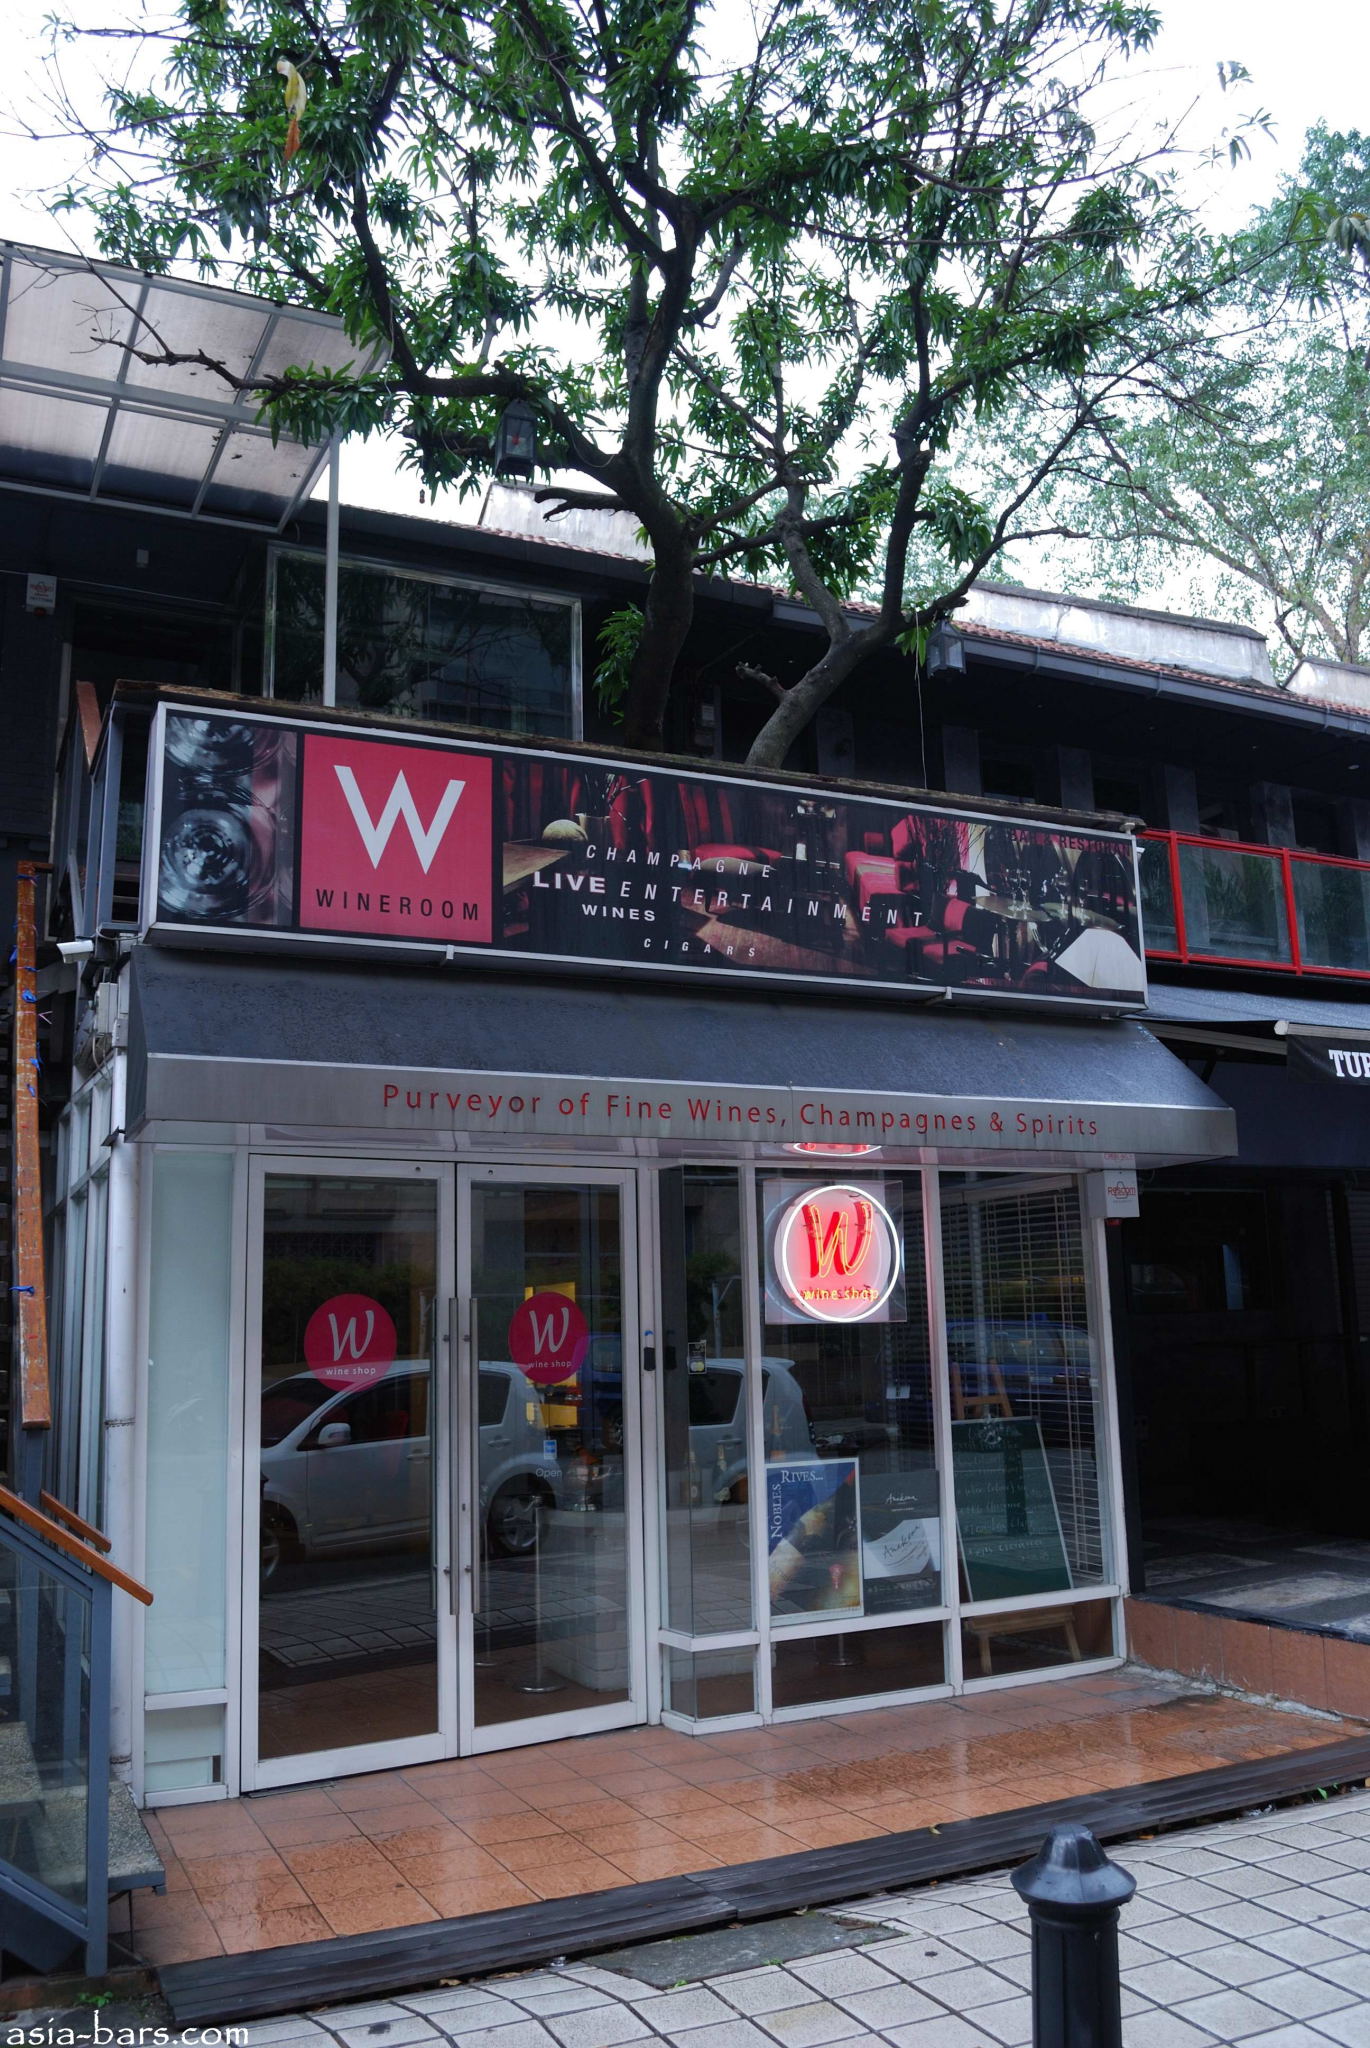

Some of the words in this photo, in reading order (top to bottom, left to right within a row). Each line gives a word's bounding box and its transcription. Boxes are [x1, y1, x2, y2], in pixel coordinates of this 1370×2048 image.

[333, 764, 467, 876] W
[585, 844, 772, 879] CHAMPAGNE
[315, 888, 479, 921] WINEROOM
[532, 871, 607, 894] LIVE
[619, 880, 923, 927] ENTERTAINMENT
[581, 903, 656, 922] WINES
[643, 937, 756, 958] CIGARS
[382, 1083, 541, 1119] Purveyor
[558, 1091, 591, 1116] of
[606, 1094, 673, 1119] Fine
[687, 1098, 786, 1128] Wines,
[800, 1103, 977, 1135] Champagnes
[989, 1111, 1004, 1133] &
[1016, 1112, 1098, 1138] Spirits
[801, 1201, 873, 1279] W
[803, 1287, 838, 1301] wine
[844, 1285, 879, 1302] shop
[327, 1309, 375, 1362] W
[528, 1306, 570, 1355] W
[325, 1367, 350, 1376] wine
[352, 1366, 377, 1376] shop
[527, 1359, 550, 1369] wine
[551, 1358, 573, 1370] shop
[770, 1482, 783, 1539] NOBLES
